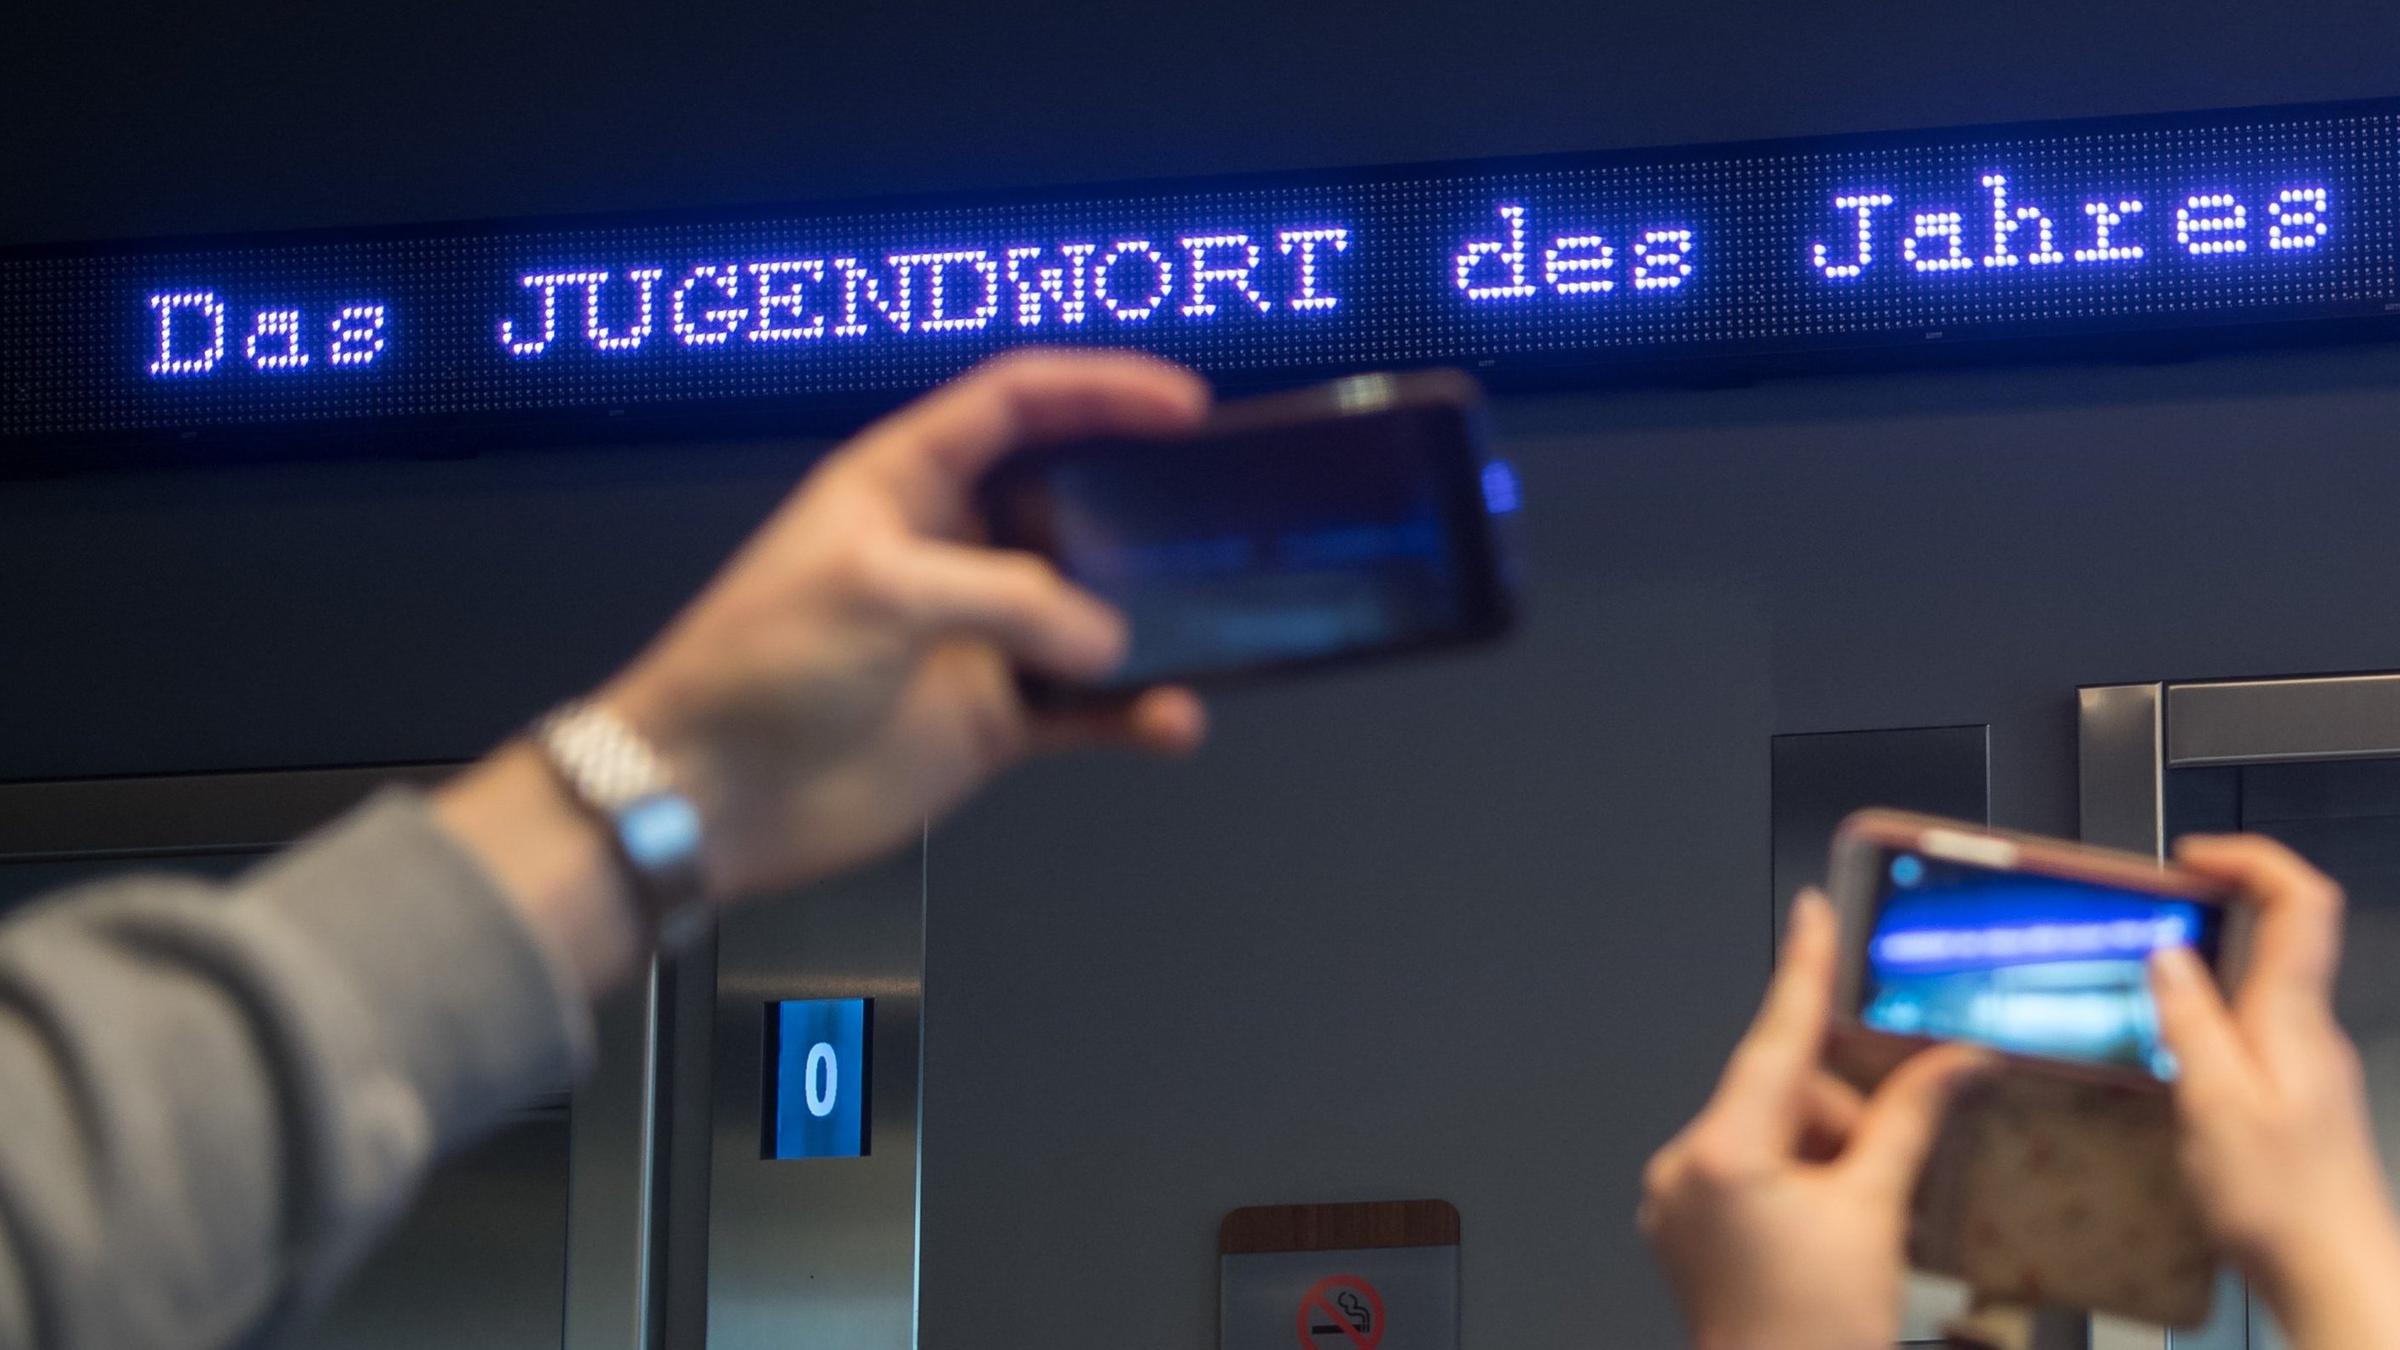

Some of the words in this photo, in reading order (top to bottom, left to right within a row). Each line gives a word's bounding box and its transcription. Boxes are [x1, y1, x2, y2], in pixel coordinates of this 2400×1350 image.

[150, 291, 384, 375] Das
[501, 227, 1348, 355] JUGENDWORT
[1454, 206, 1692, 299] des
[1813, 174, 2328, 279] Jahres
[805, 1042, 838, 1117] 0
